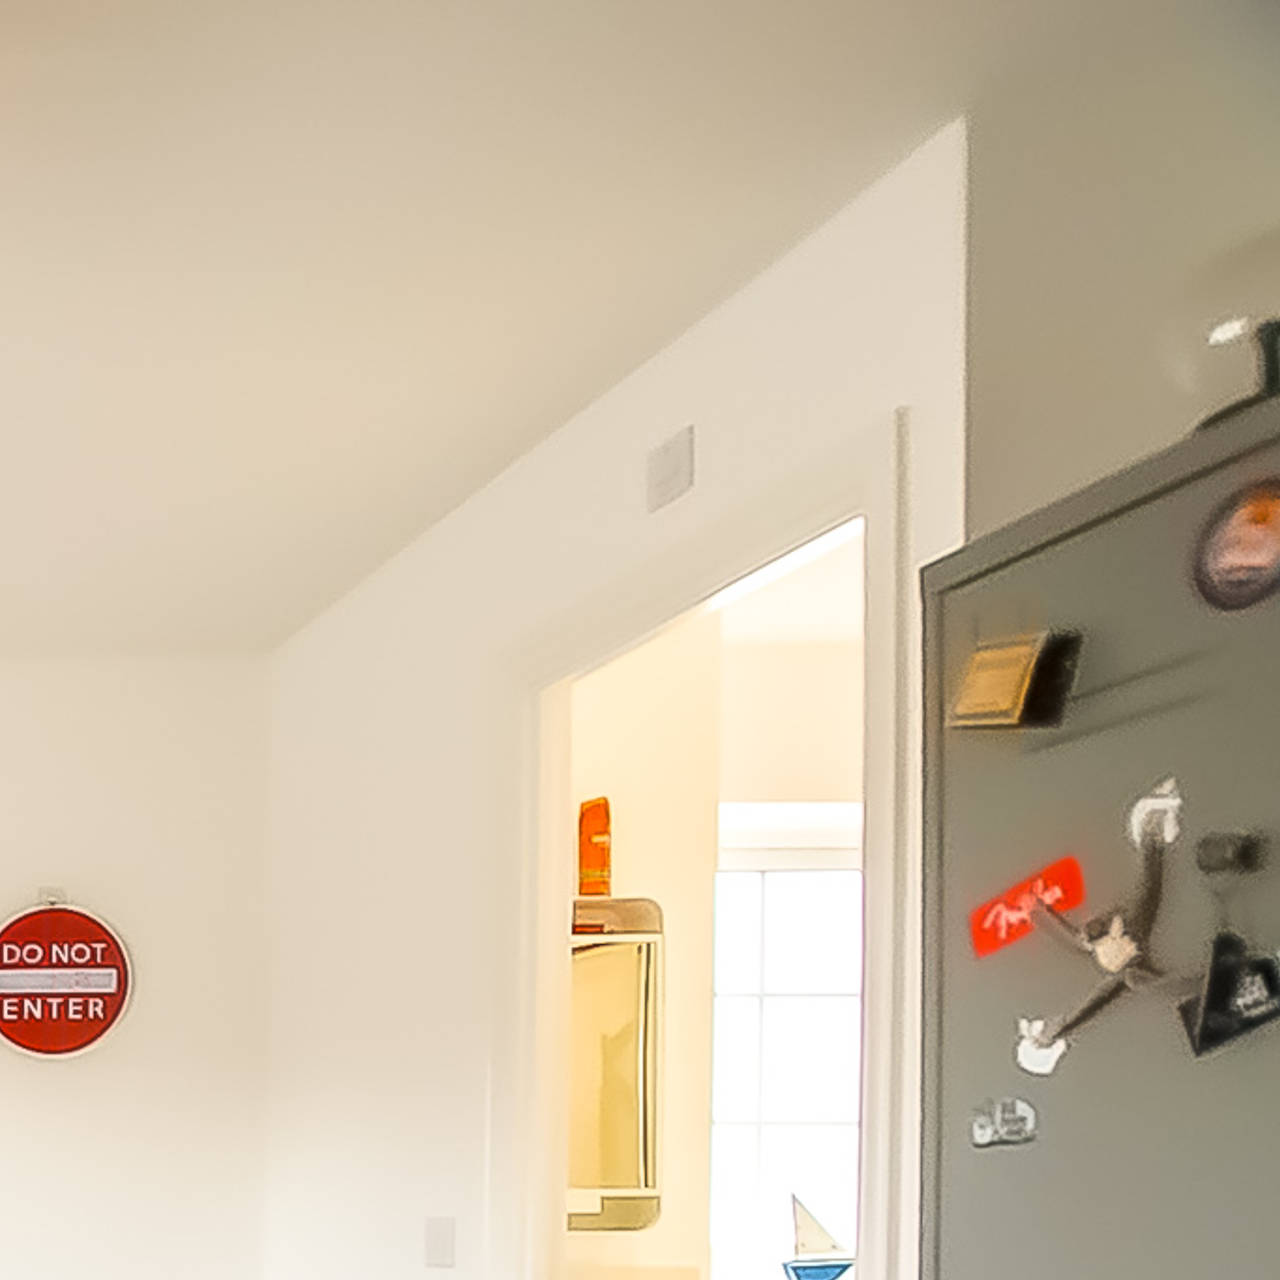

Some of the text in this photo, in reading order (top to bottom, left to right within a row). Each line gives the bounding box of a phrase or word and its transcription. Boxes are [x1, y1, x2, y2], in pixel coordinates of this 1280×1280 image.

[2, 943, 107, 964] DO NOT
[2, 997, 105, 1020] ENTER
